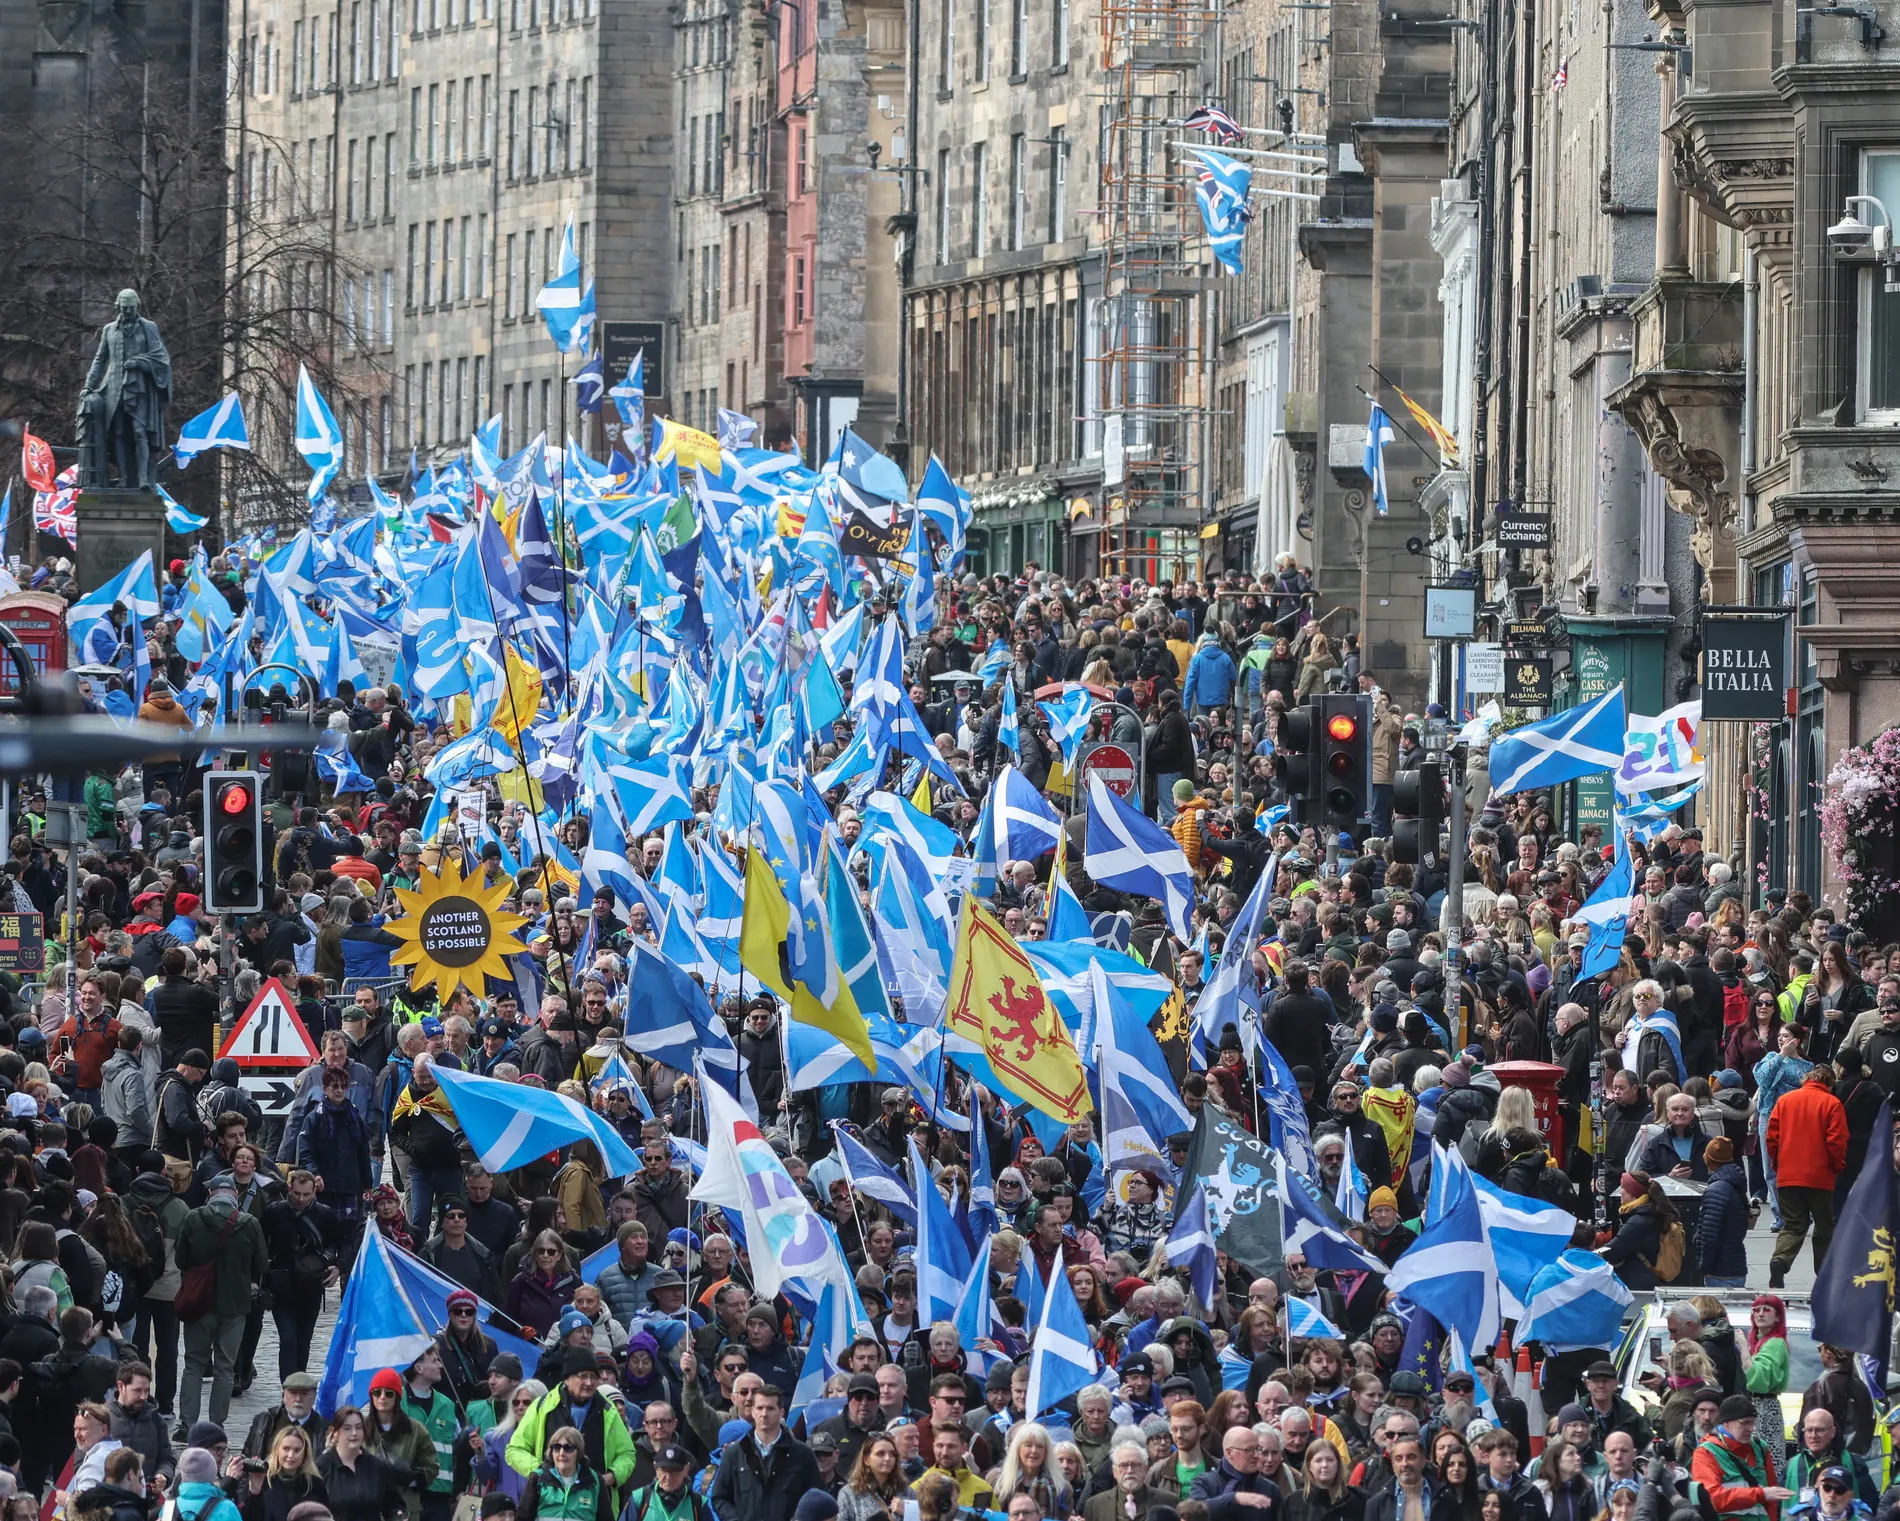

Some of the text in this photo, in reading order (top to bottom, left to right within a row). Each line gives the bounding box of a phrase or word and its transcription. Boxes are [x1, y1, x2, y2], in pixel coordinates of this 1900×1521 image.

[1502, 521, 1547, 531] Currency
[1500, 531, 1547, 542] Exchange
[1511, 624, 1545, 634] BELHAVEN
[1708, 649, 1771, 668] BELLA
[1582, 680, 1605, 690] CASK
[1708, 672, 1773, 691] ITALIA
[1584, 797, 1597, 807] THE
[429, 911, 479, 924] ANOTHER
[1, 916, 20, 937] 福
[427, 924, 482, 937] SCOTLAND
[426, 937, 486, 950] IS POSSIBLE
